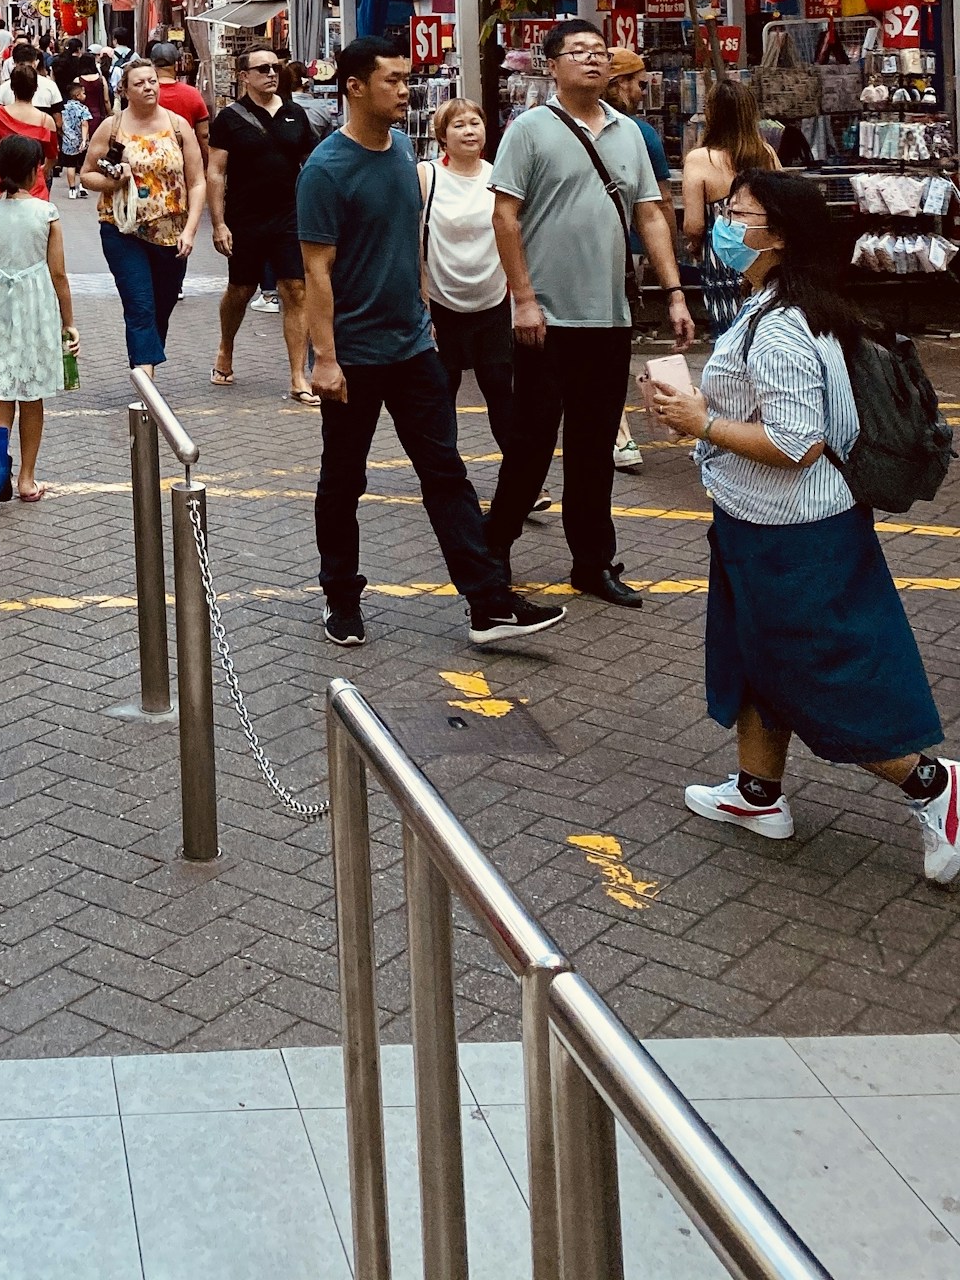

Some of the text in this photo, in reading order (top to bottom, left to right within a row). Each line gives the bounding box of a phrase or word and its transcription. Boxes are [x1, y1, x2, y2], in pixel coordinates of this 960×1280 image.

[524, 25, 530, 43] 2
[616, 14, 636, 51] $2
[885, 5, 919, 38] $2
[416, 20, 437, 61] $1
[725, 37, 739, 51] $5
